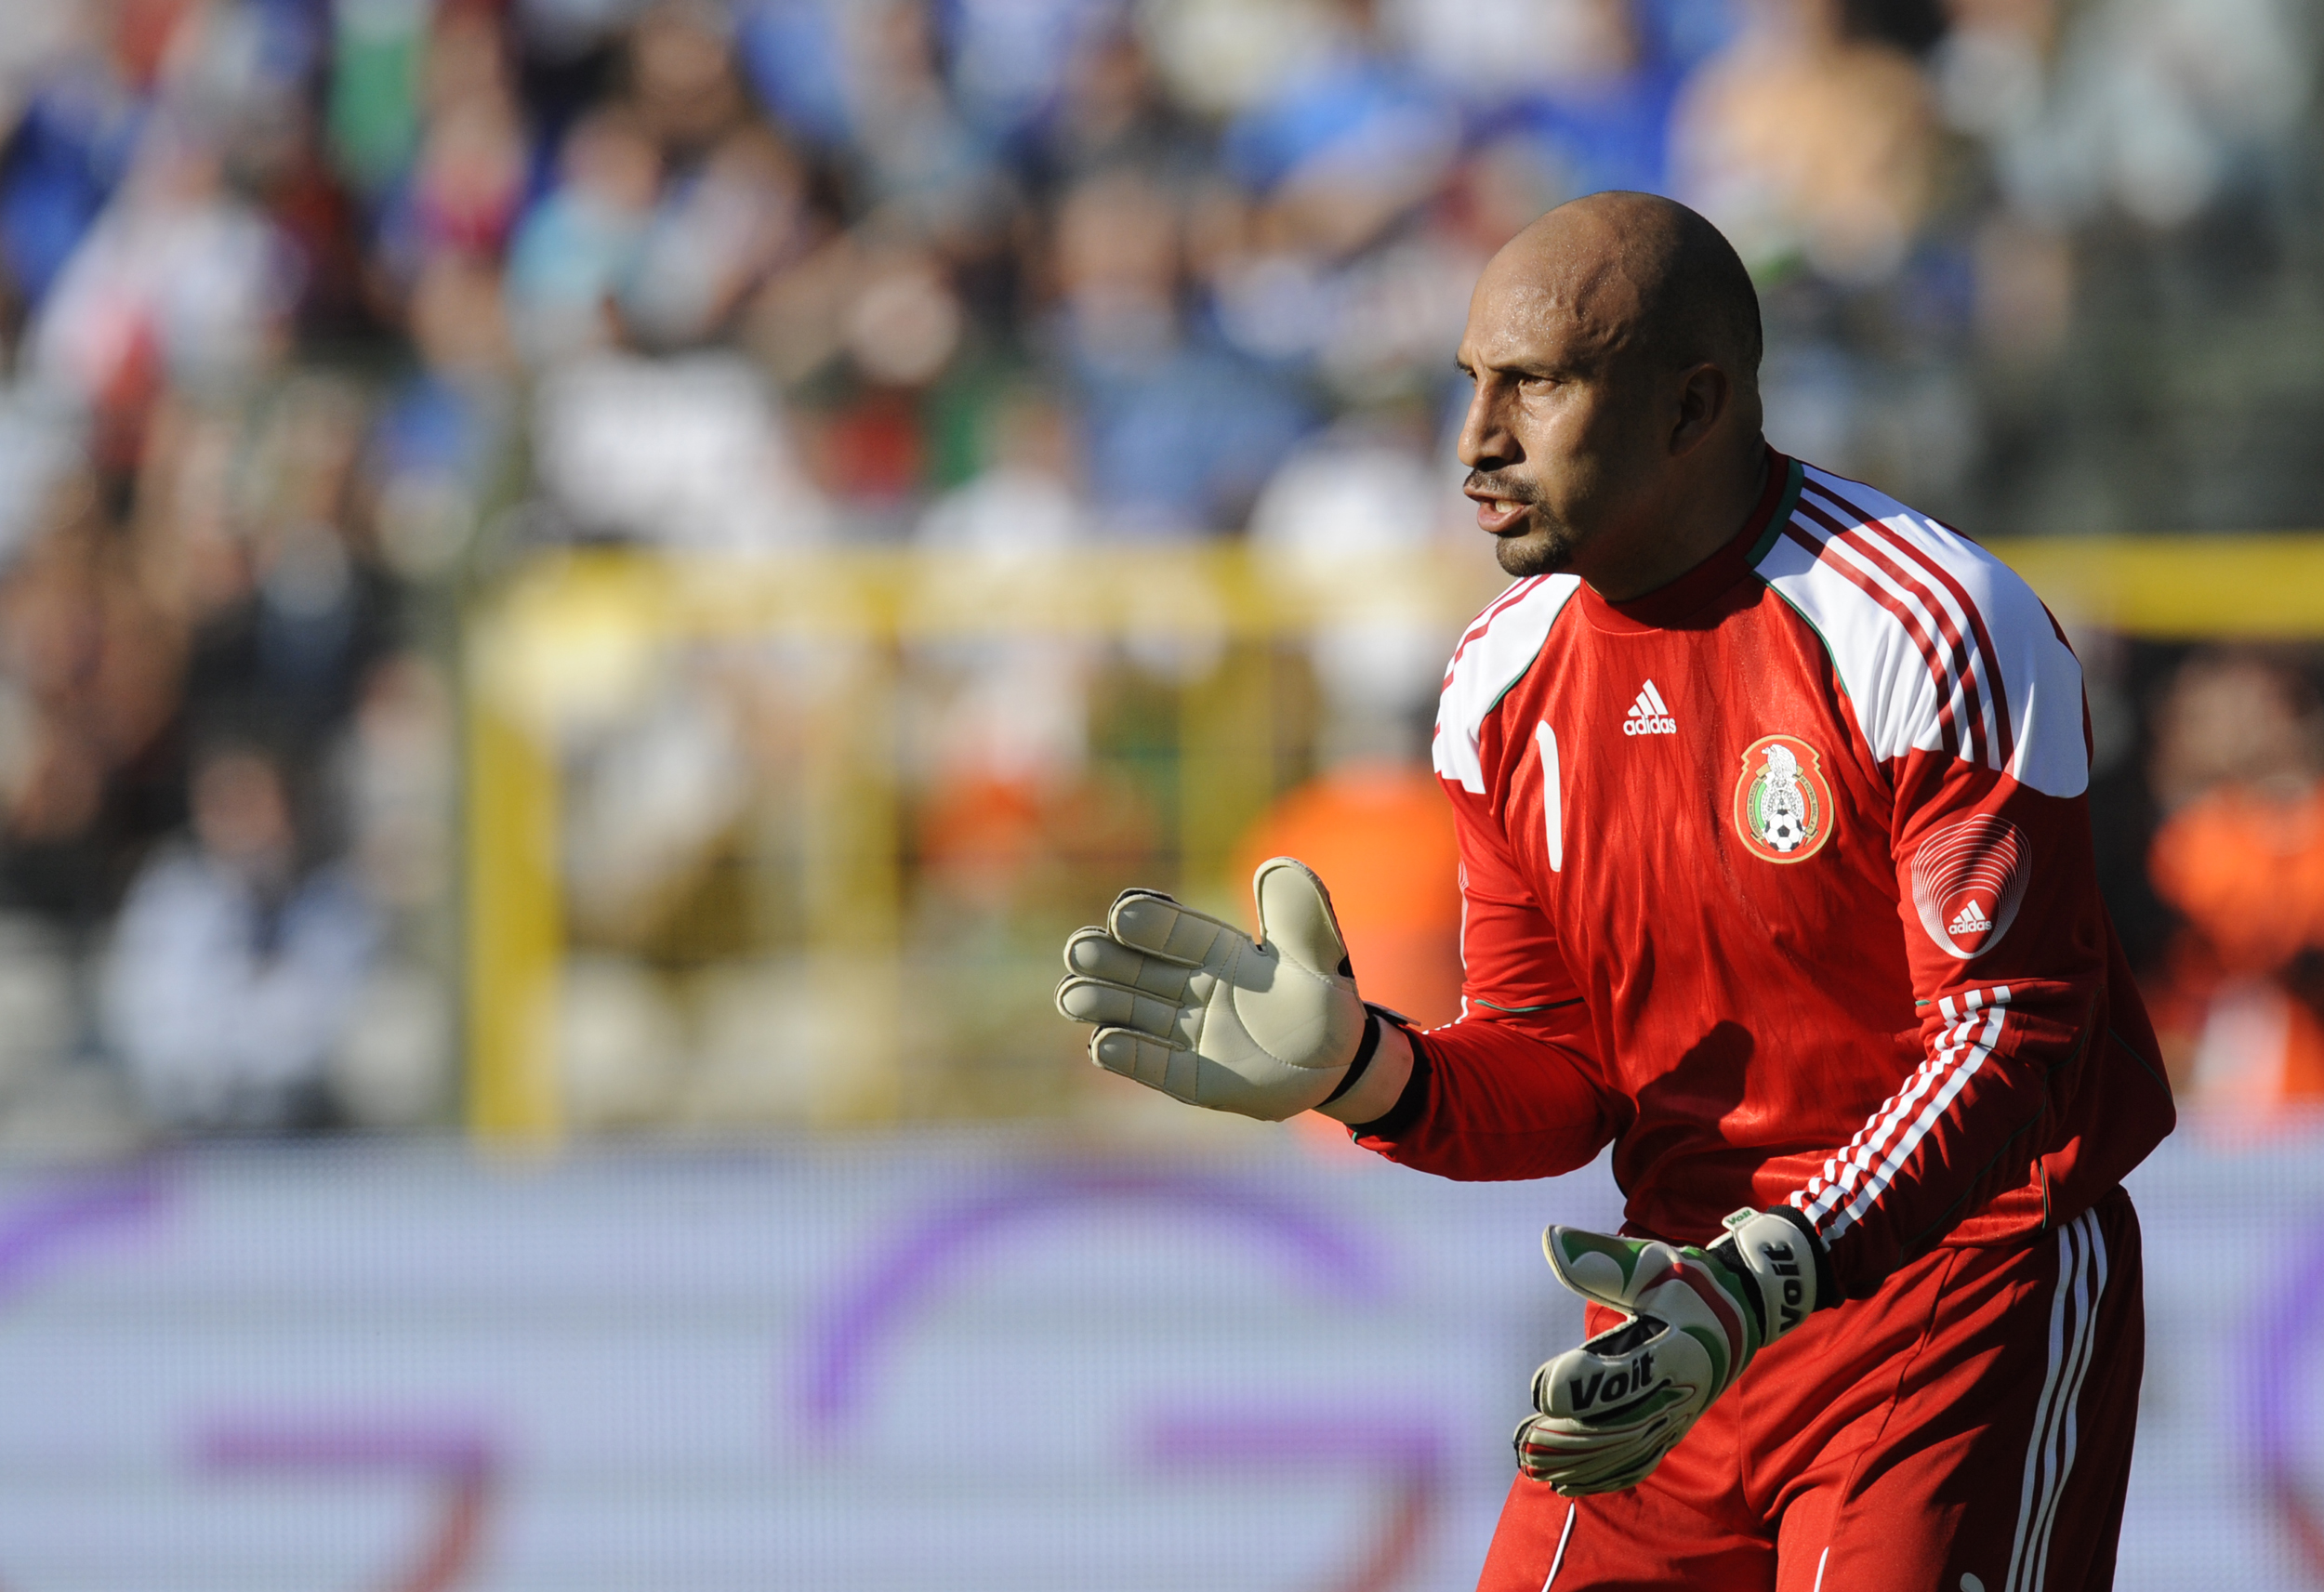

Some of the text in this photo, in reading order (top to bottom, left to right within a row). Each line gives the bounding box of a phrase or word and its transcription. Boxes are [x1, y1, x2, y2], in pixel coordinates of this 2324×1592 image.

[1623, 715, 1677, 736] adidas
[1536, 719, 1563, 873] 1
[1948, 920, 1992, 935] adidas
[1763, 1243, 1802, 1334] Voit
[1570, 1350, 1655, 1412] Voit
